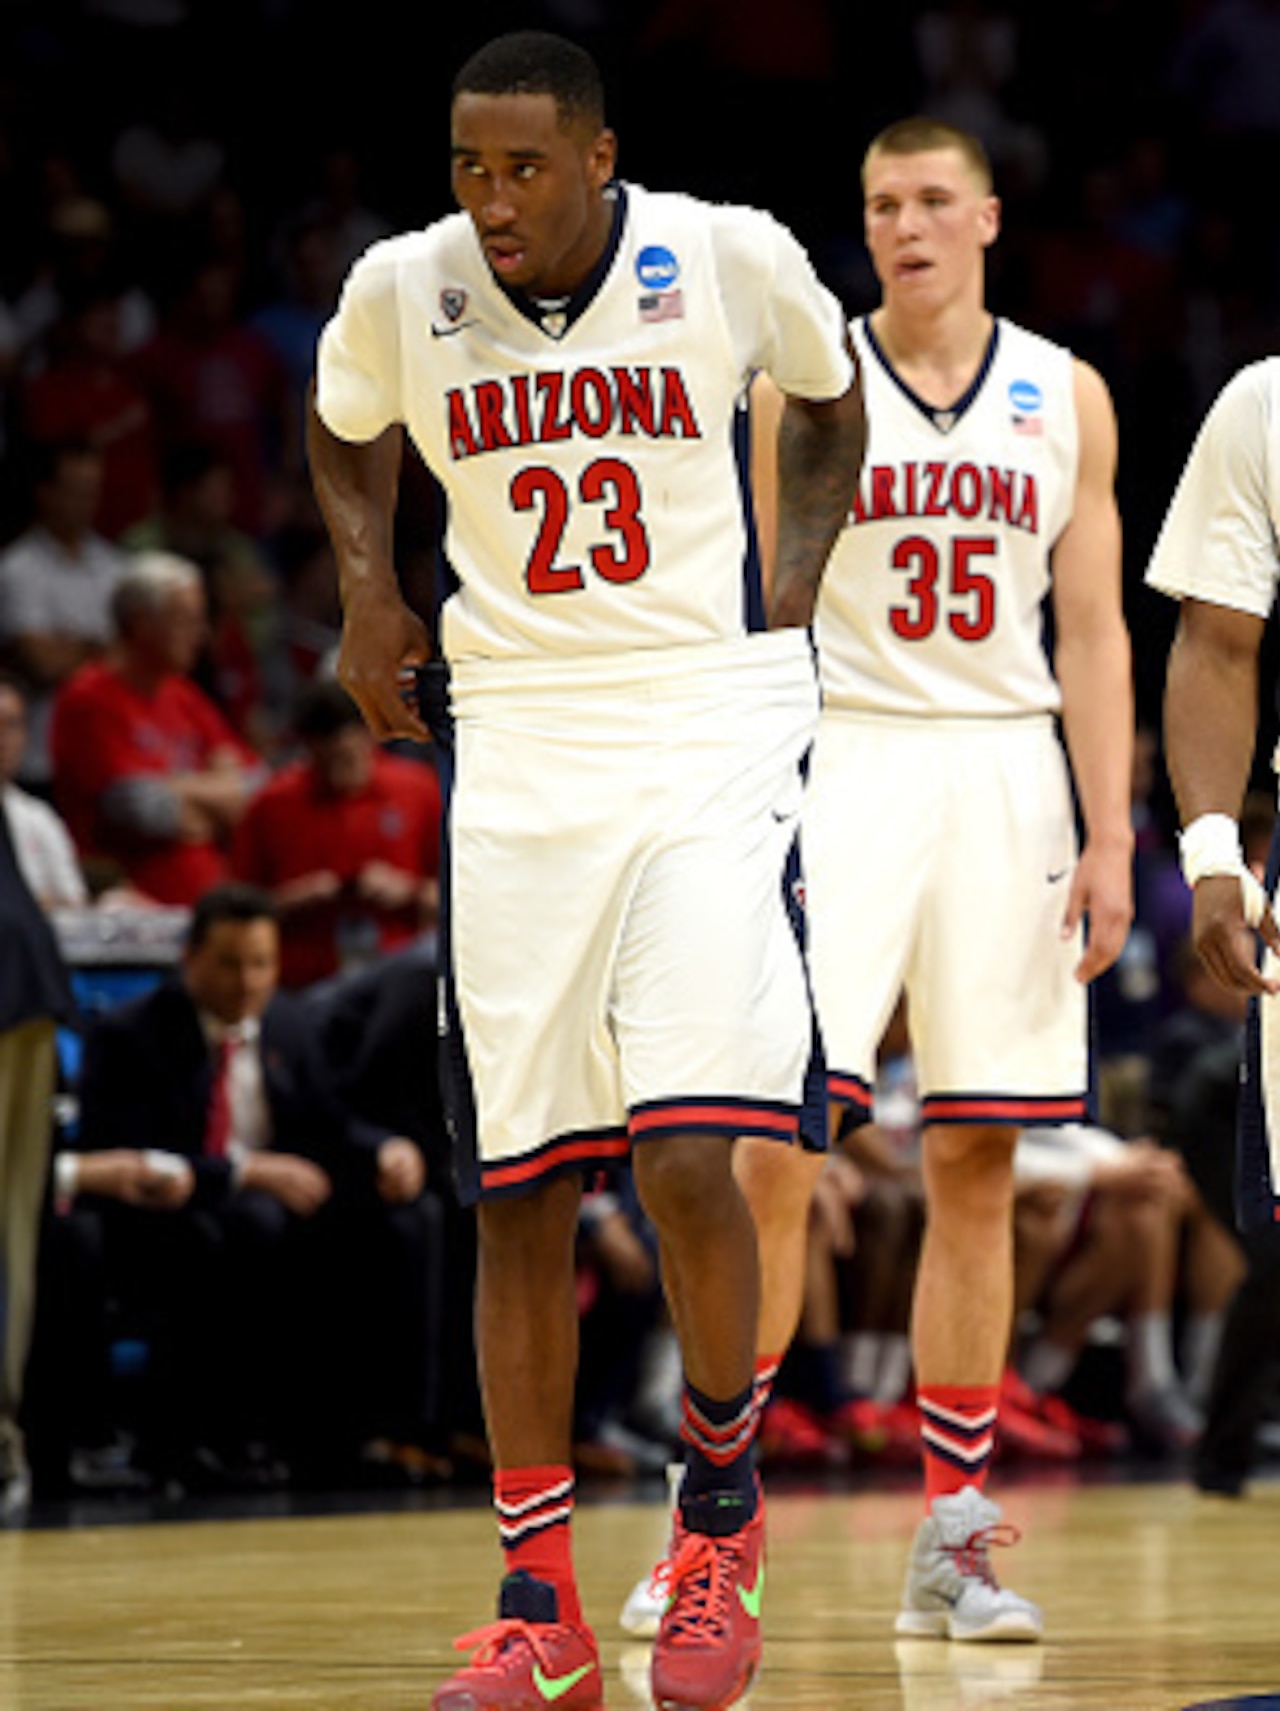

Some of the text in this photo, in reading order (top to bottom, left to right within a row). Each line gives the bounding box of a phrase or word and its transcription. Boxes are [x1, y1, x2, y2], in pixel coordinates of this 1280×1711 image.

[445, 366, 701, 460] ARIZONA
[509, 458, 650, 595] 23
[889, 536, 996, 641] 35
